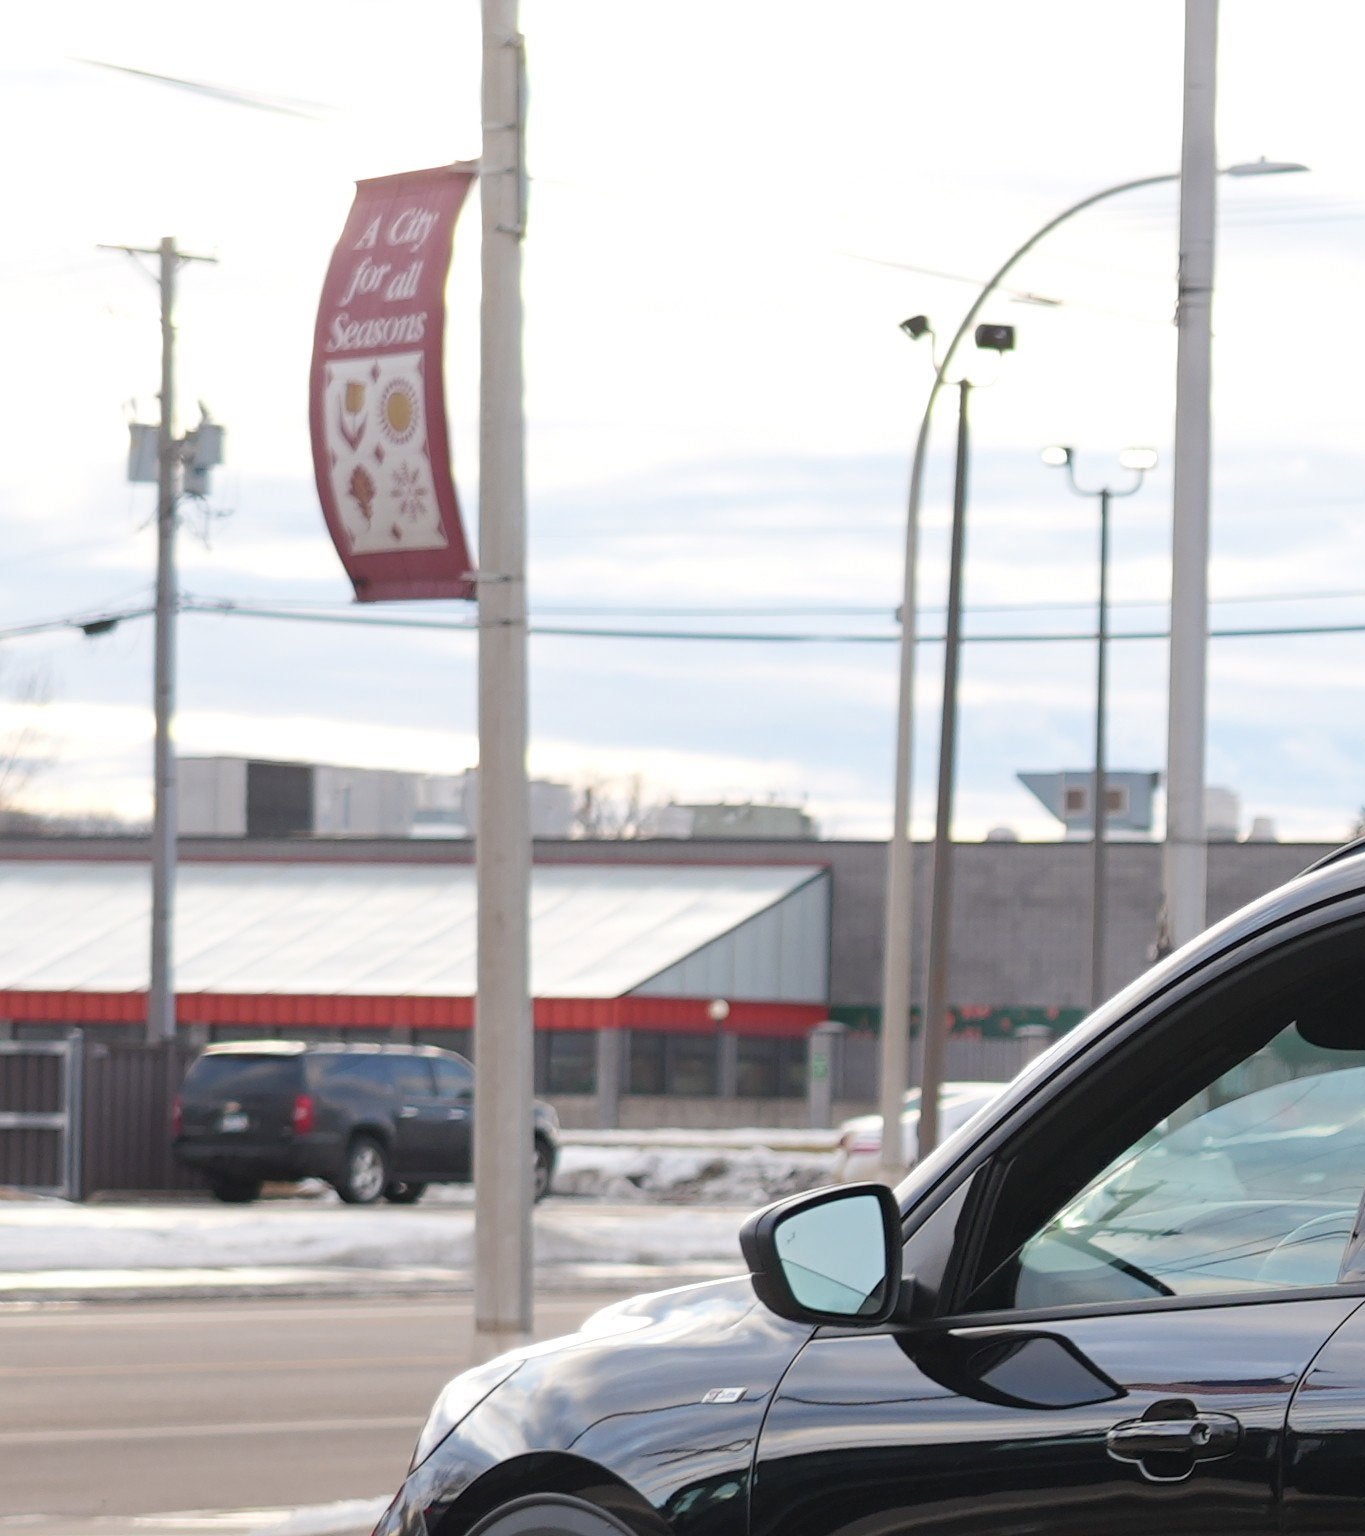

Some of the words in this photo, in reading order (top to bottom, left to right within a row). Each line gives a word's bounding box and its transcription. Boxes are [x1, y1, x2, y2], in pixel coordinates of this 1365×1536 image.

[354, 214, 382, 251] A
[388, 207, 440, 252] City
[338, 256, 391, 306] for
[385, 259, 424, 302] all
[325, 311, 427, 350] Seasons
